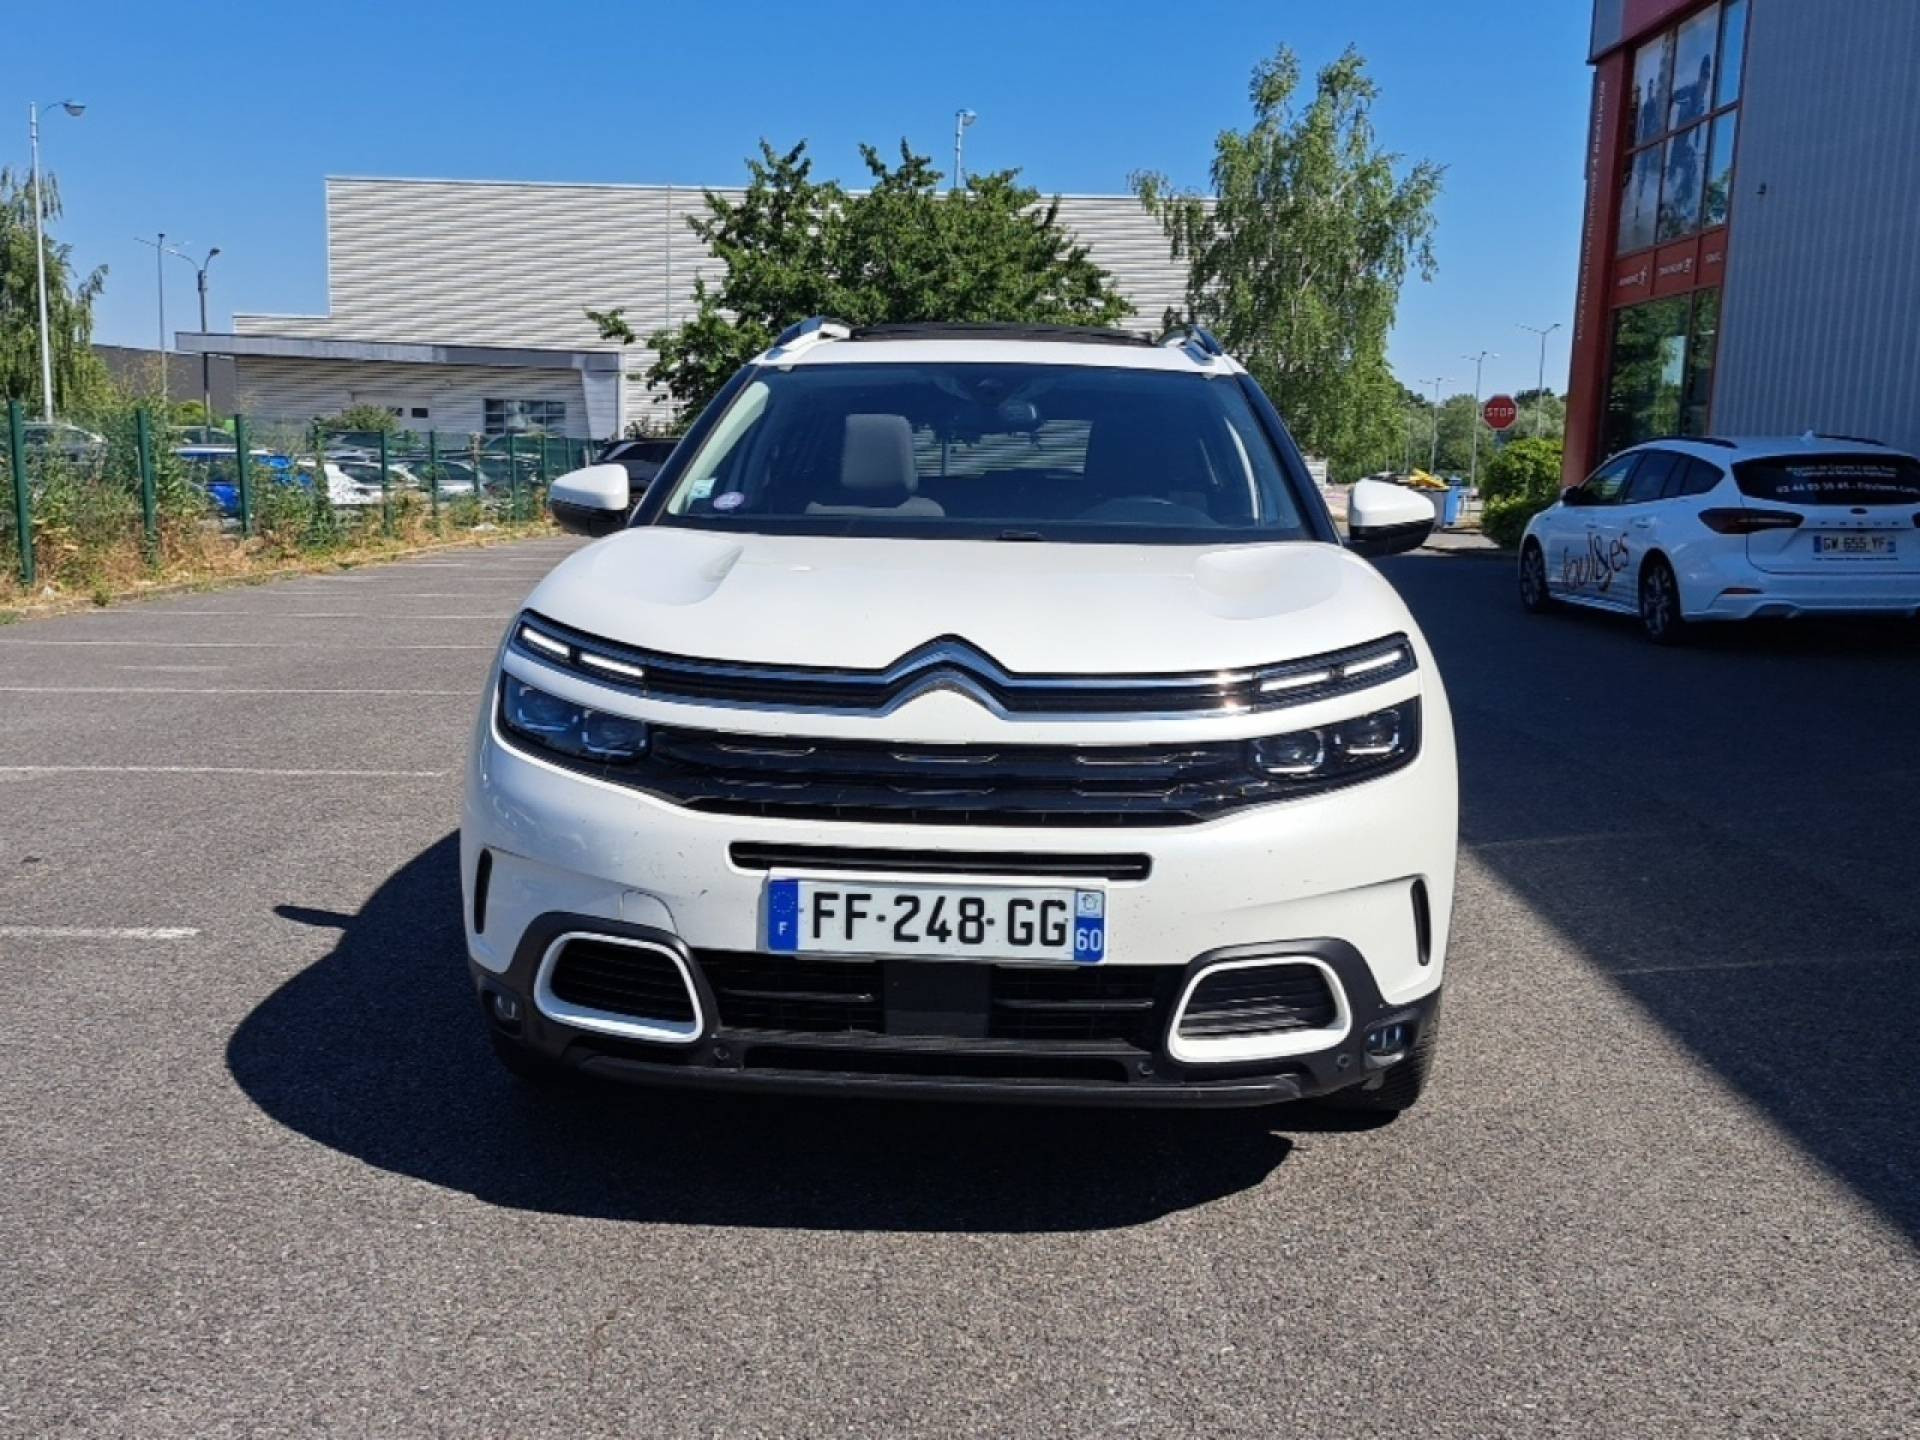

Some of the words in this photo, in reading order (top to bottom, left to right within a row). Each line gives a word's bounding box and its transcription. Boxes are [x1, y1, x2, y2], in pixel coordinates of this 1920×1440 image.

[1484, 407, 1514, 417] STOP
[778, 921, 788, 937] F
[812, 891, 1067, 947] FF-248-GG
[1075, 929, 1101, 952] 60
